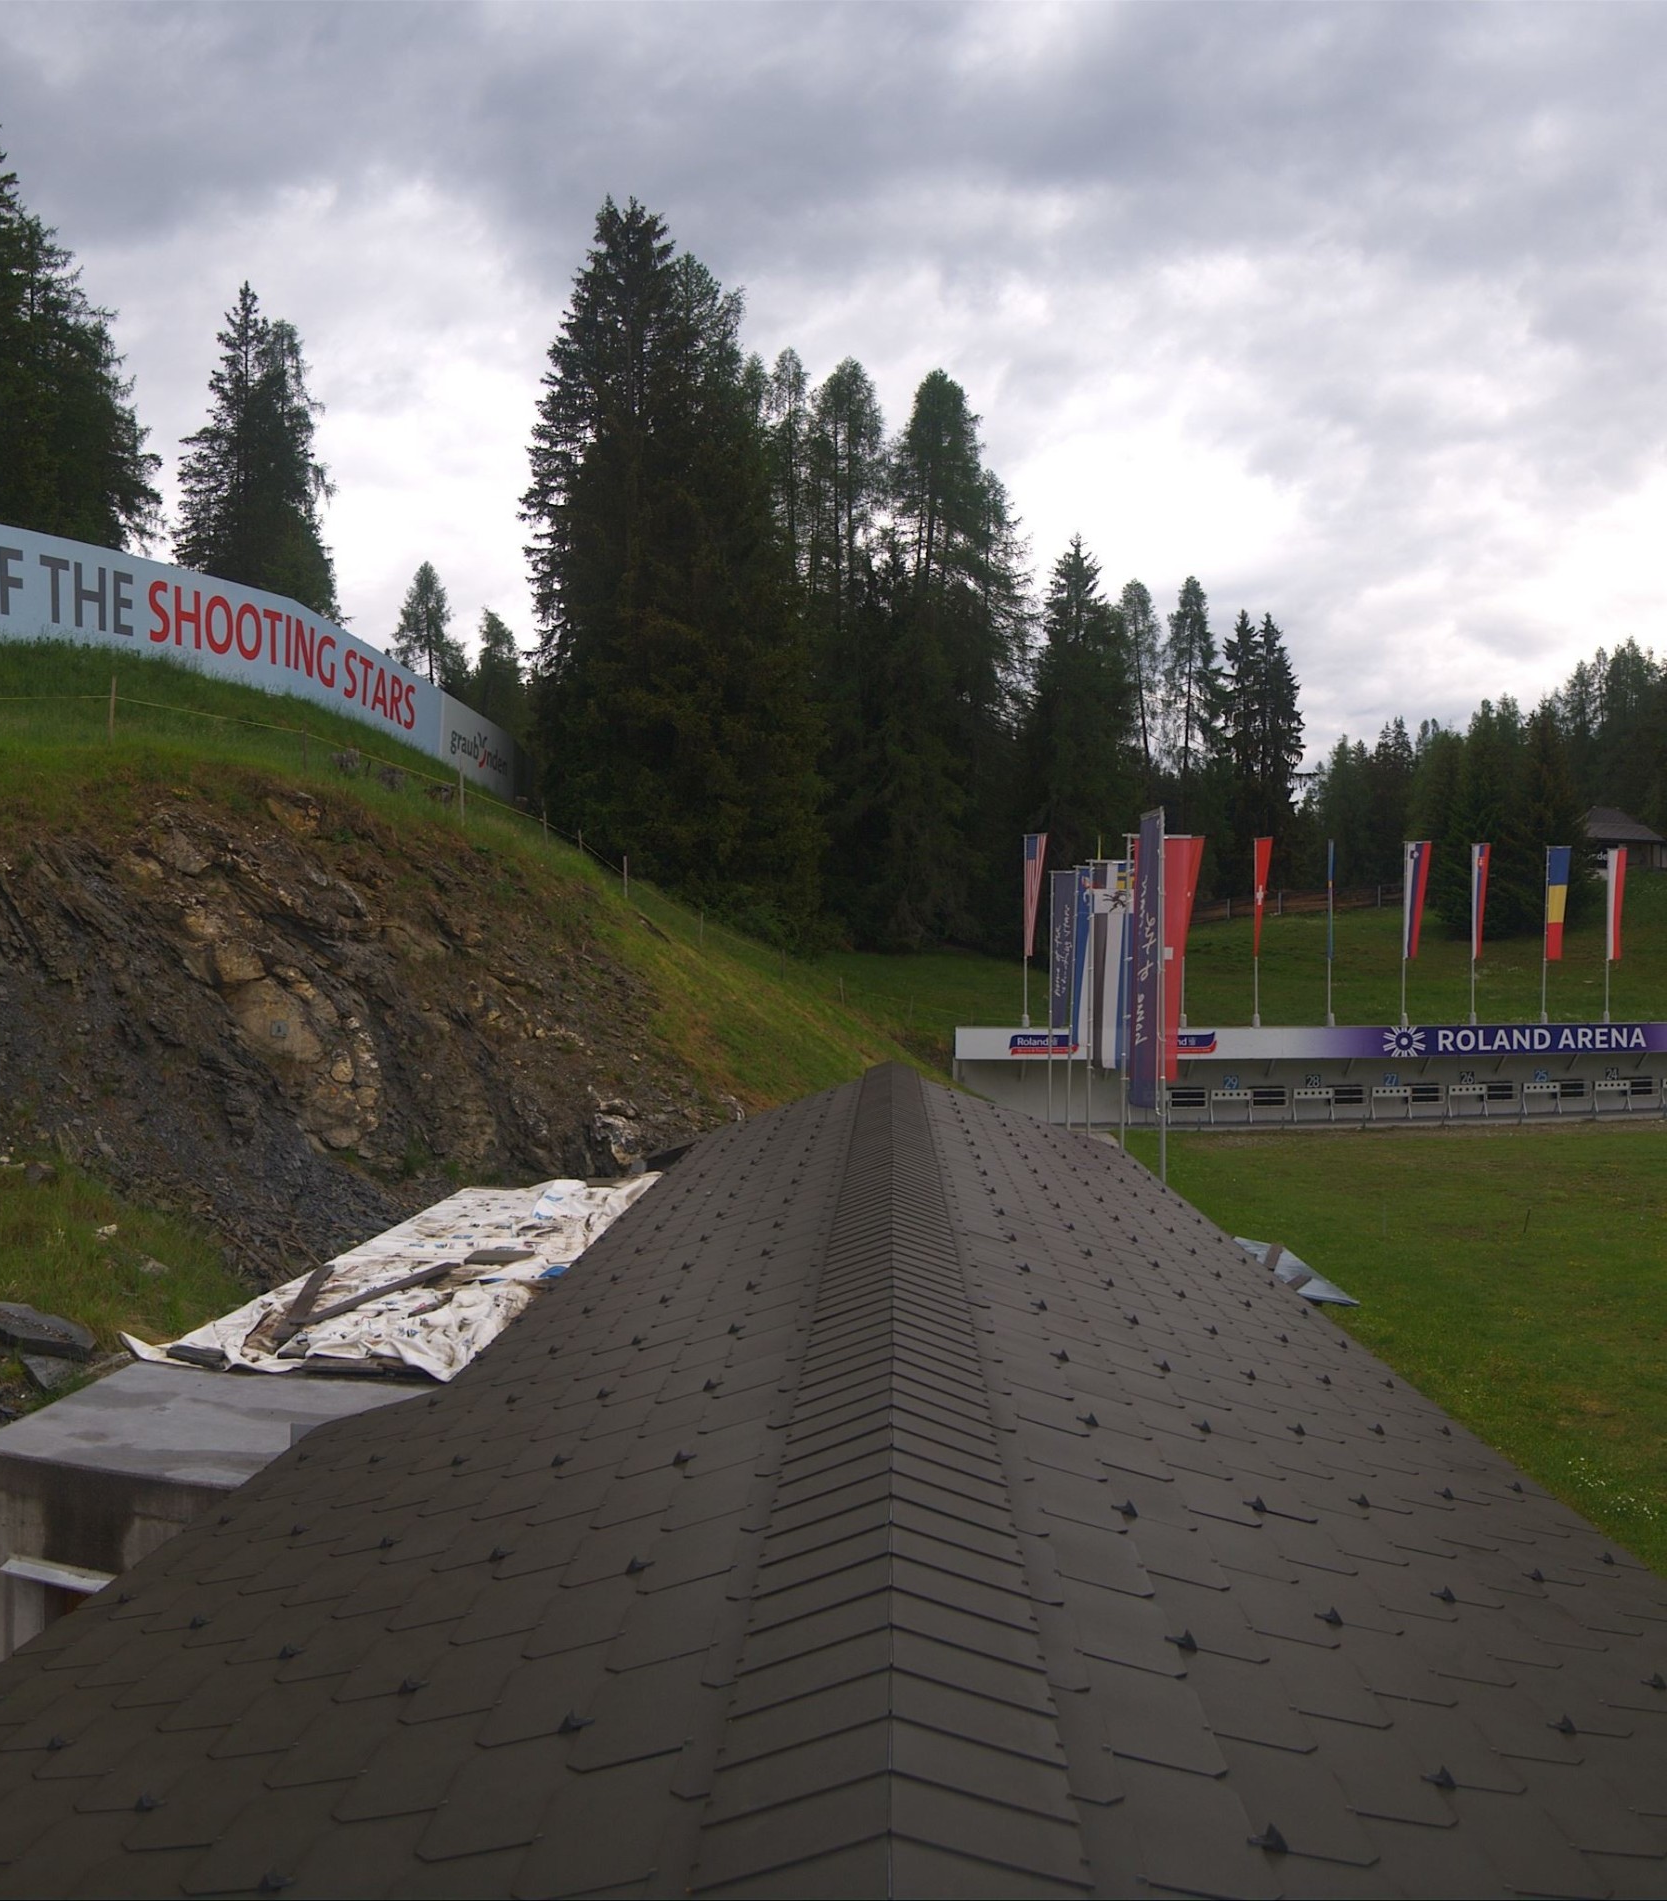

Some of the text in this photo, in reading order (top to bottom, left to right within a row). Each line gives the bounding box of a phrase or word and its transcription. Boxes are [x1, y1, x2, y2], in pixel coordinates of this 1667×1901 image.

[39, 554, 134, 637] THE
[148, 580, 336, 688] SHOOTING
[343, 649, 416, 730] STARS
[1016, 1036, 1049, 1047] Roland
[1437, 1026, 1648, 1052] ROLAND ARENA
[1384, 1073, 1398, 1087] 27
[1460, 1071, 1475, 1085] 26
[1534, 1069, 1548, 1083] 25
[1605, 1067, 1619, 1081] 24
[1223, 1076, 1238, 1089] 29
[1305, 1075, 1320, 1088] 28
